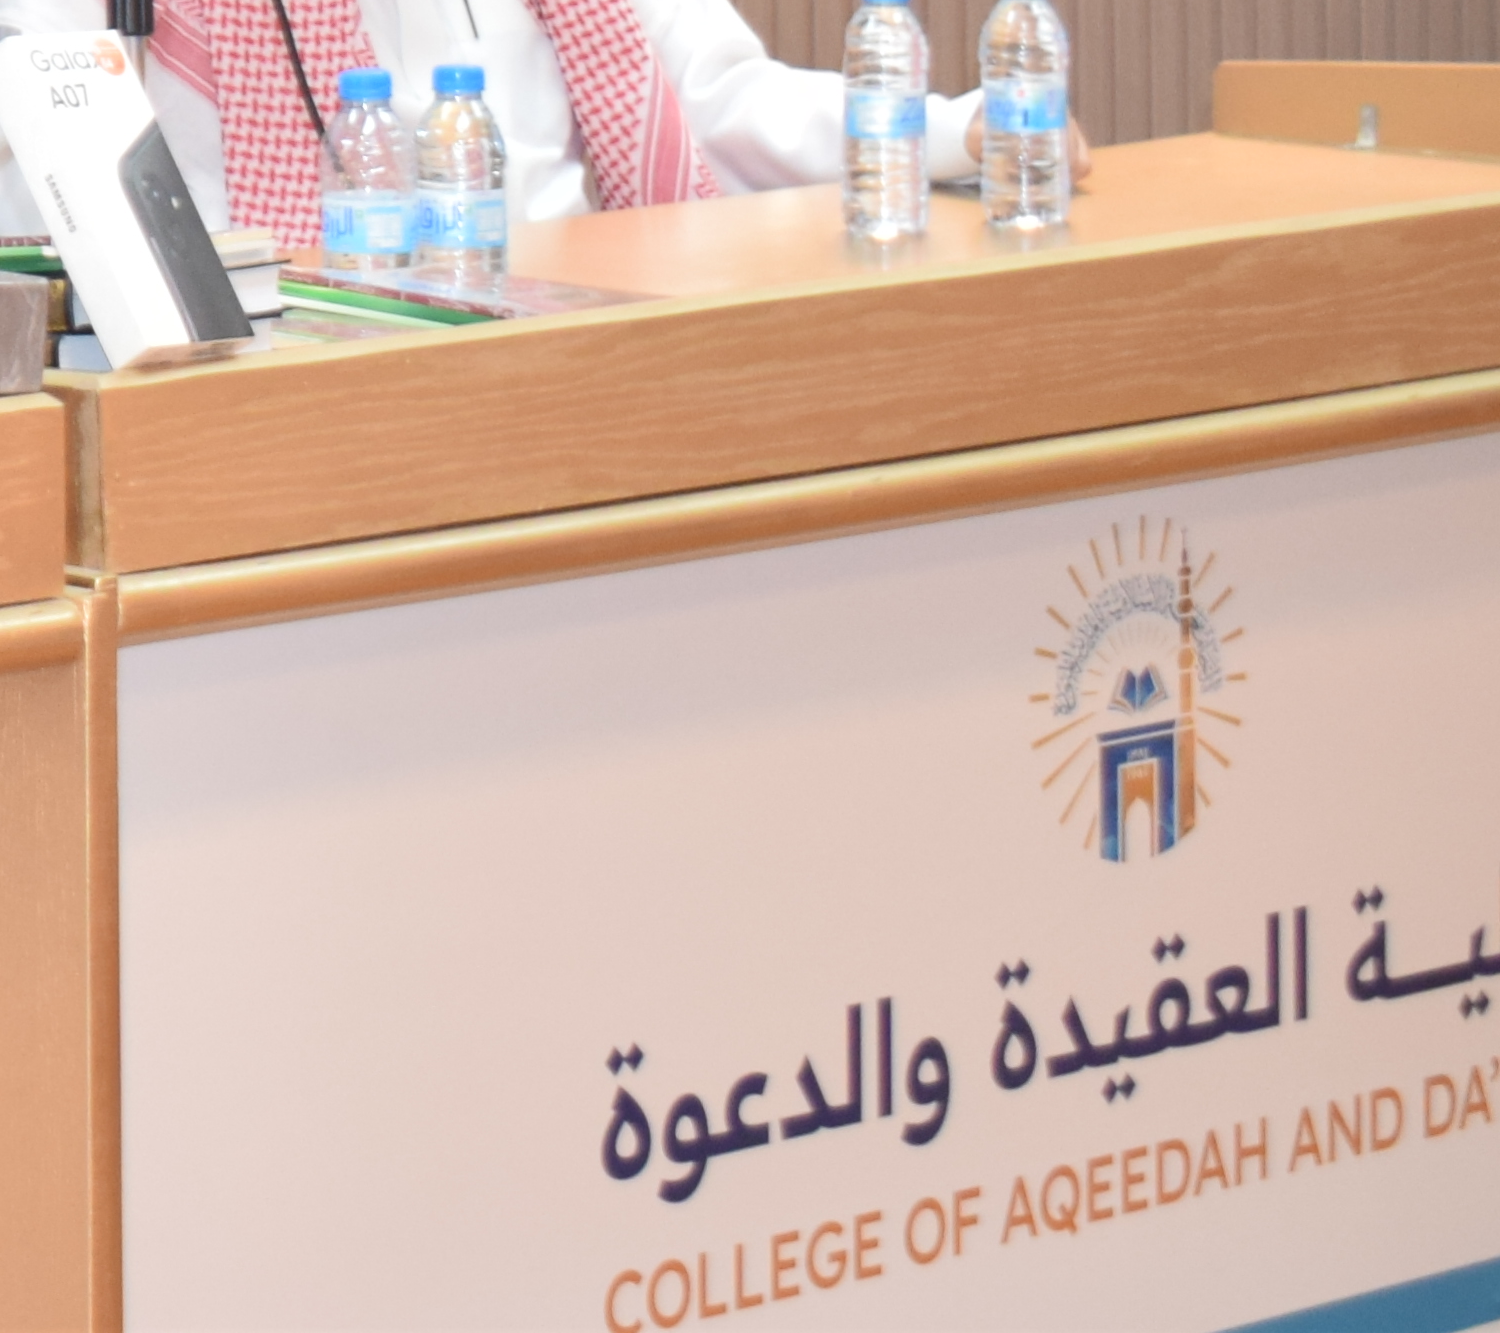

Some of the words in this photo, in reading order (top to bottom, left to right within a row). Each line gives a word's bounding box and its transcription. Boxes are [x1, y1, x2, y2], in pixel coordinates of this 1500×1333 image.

[29, 47, 104, 73] Galax
[50, 83, 89, 109] A07
[44, 172, 77, 233] SAMSUNG
[990, 904, 1311, 1104] العقيدة
[601, 996, 951, 1204] والدعوة
[604, 1209, 884, 1333] COLLEGE
[904, 1186, 982, 1265] OF
[1000, 1116, 1269, 1245] AQEEDAH
[1288, 1085, 1405, 1173] AND
